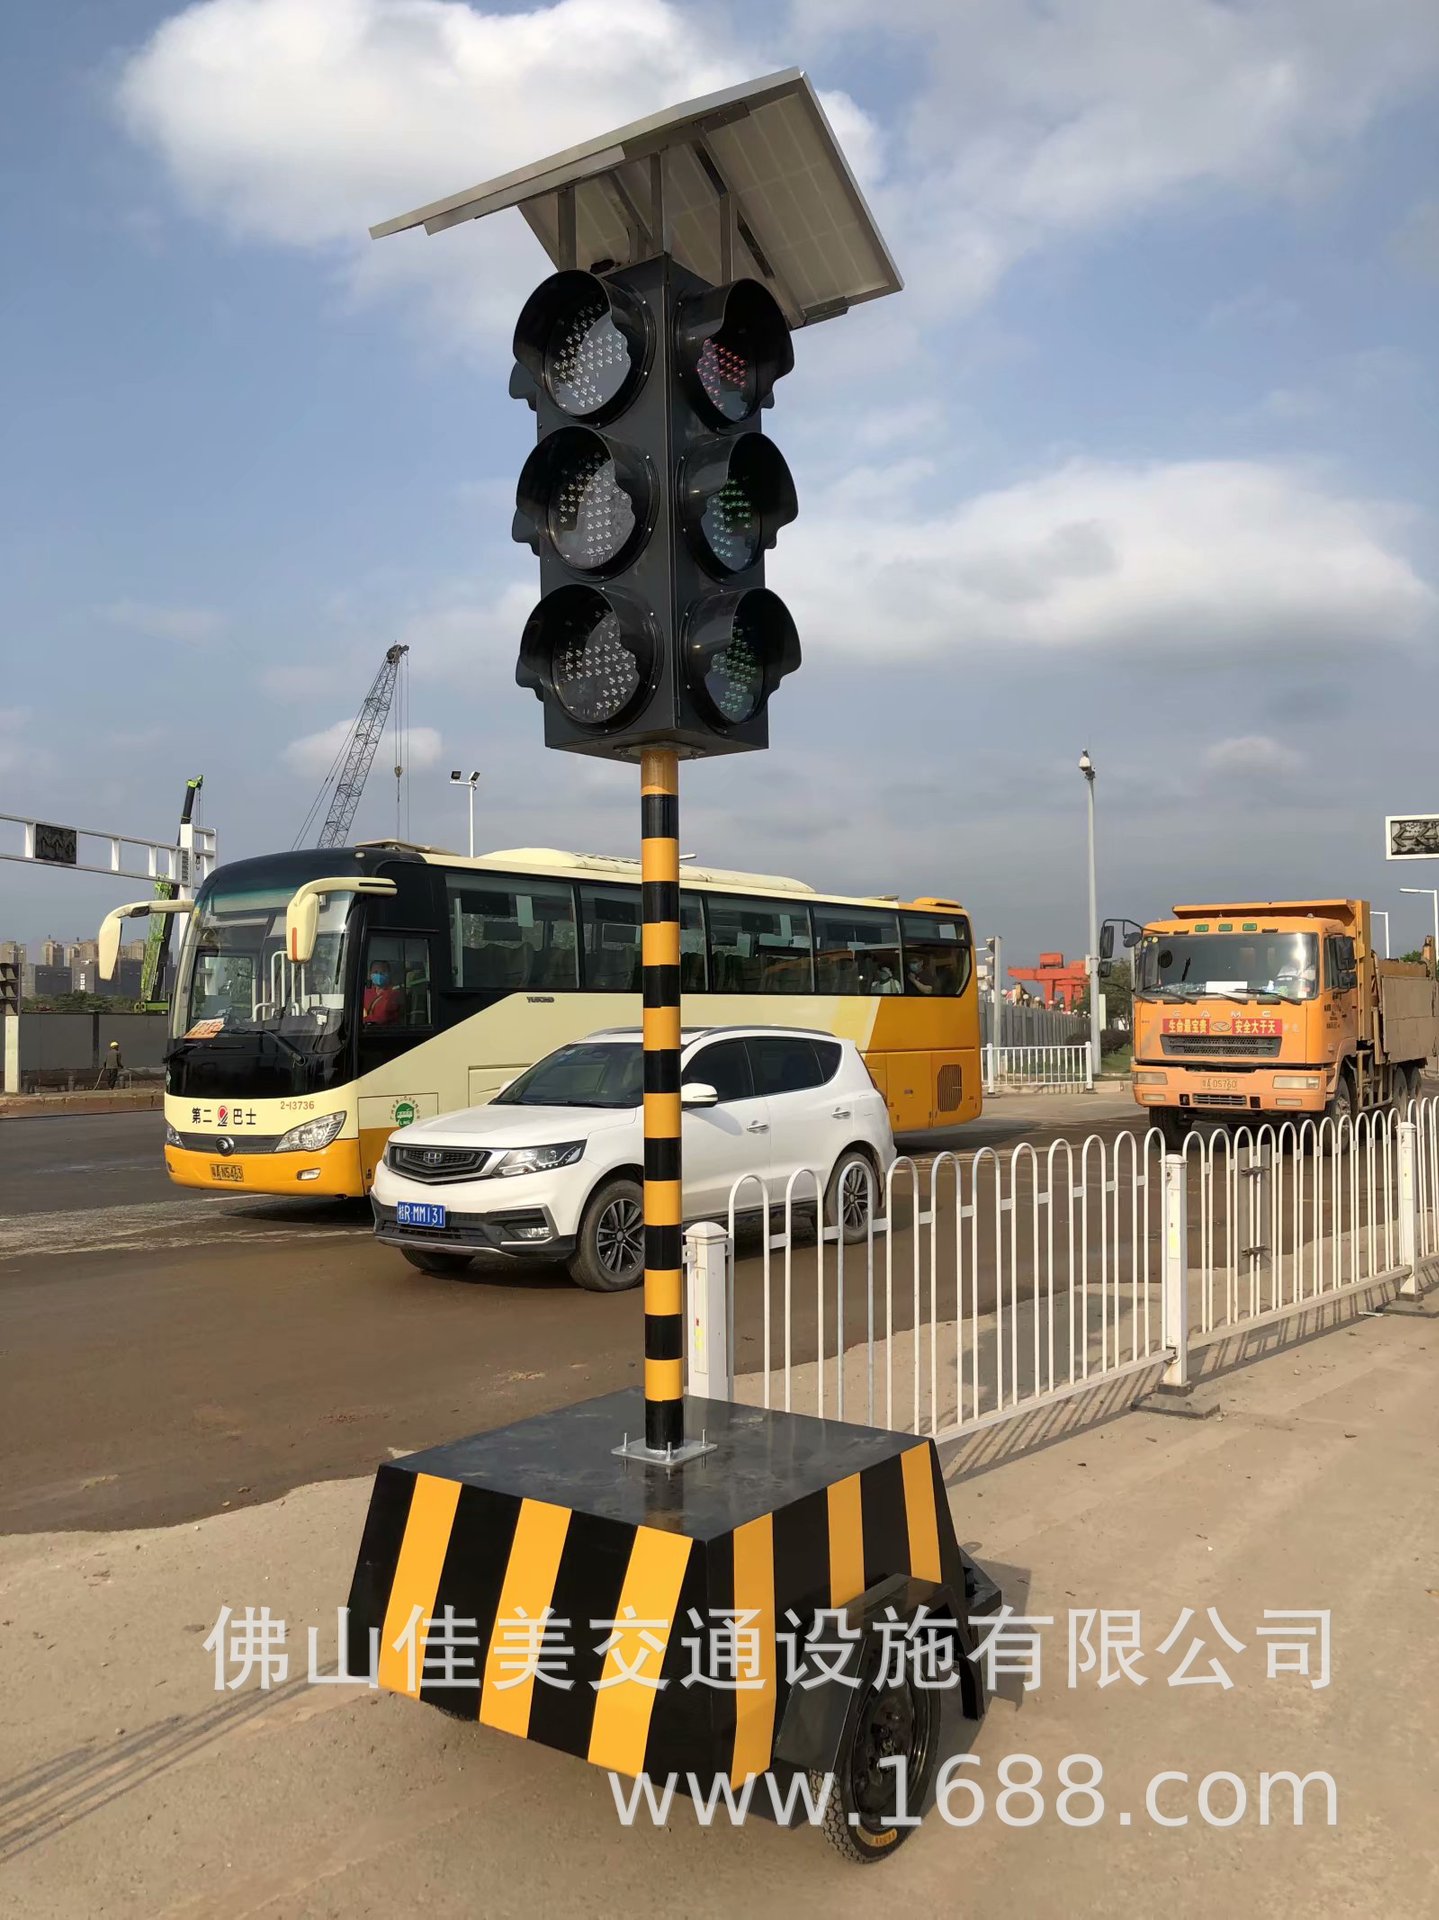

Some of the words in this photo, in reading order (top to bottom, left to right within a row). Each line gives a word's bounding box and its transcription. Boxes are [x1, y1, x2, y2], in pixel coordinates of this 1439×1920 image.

[1168, 1019, 1207, 1033] 生命最宝贵
[1235, 1020, 1276, 1034] 安全大于天
[280, 1101, 315, 1110] 2-13736
